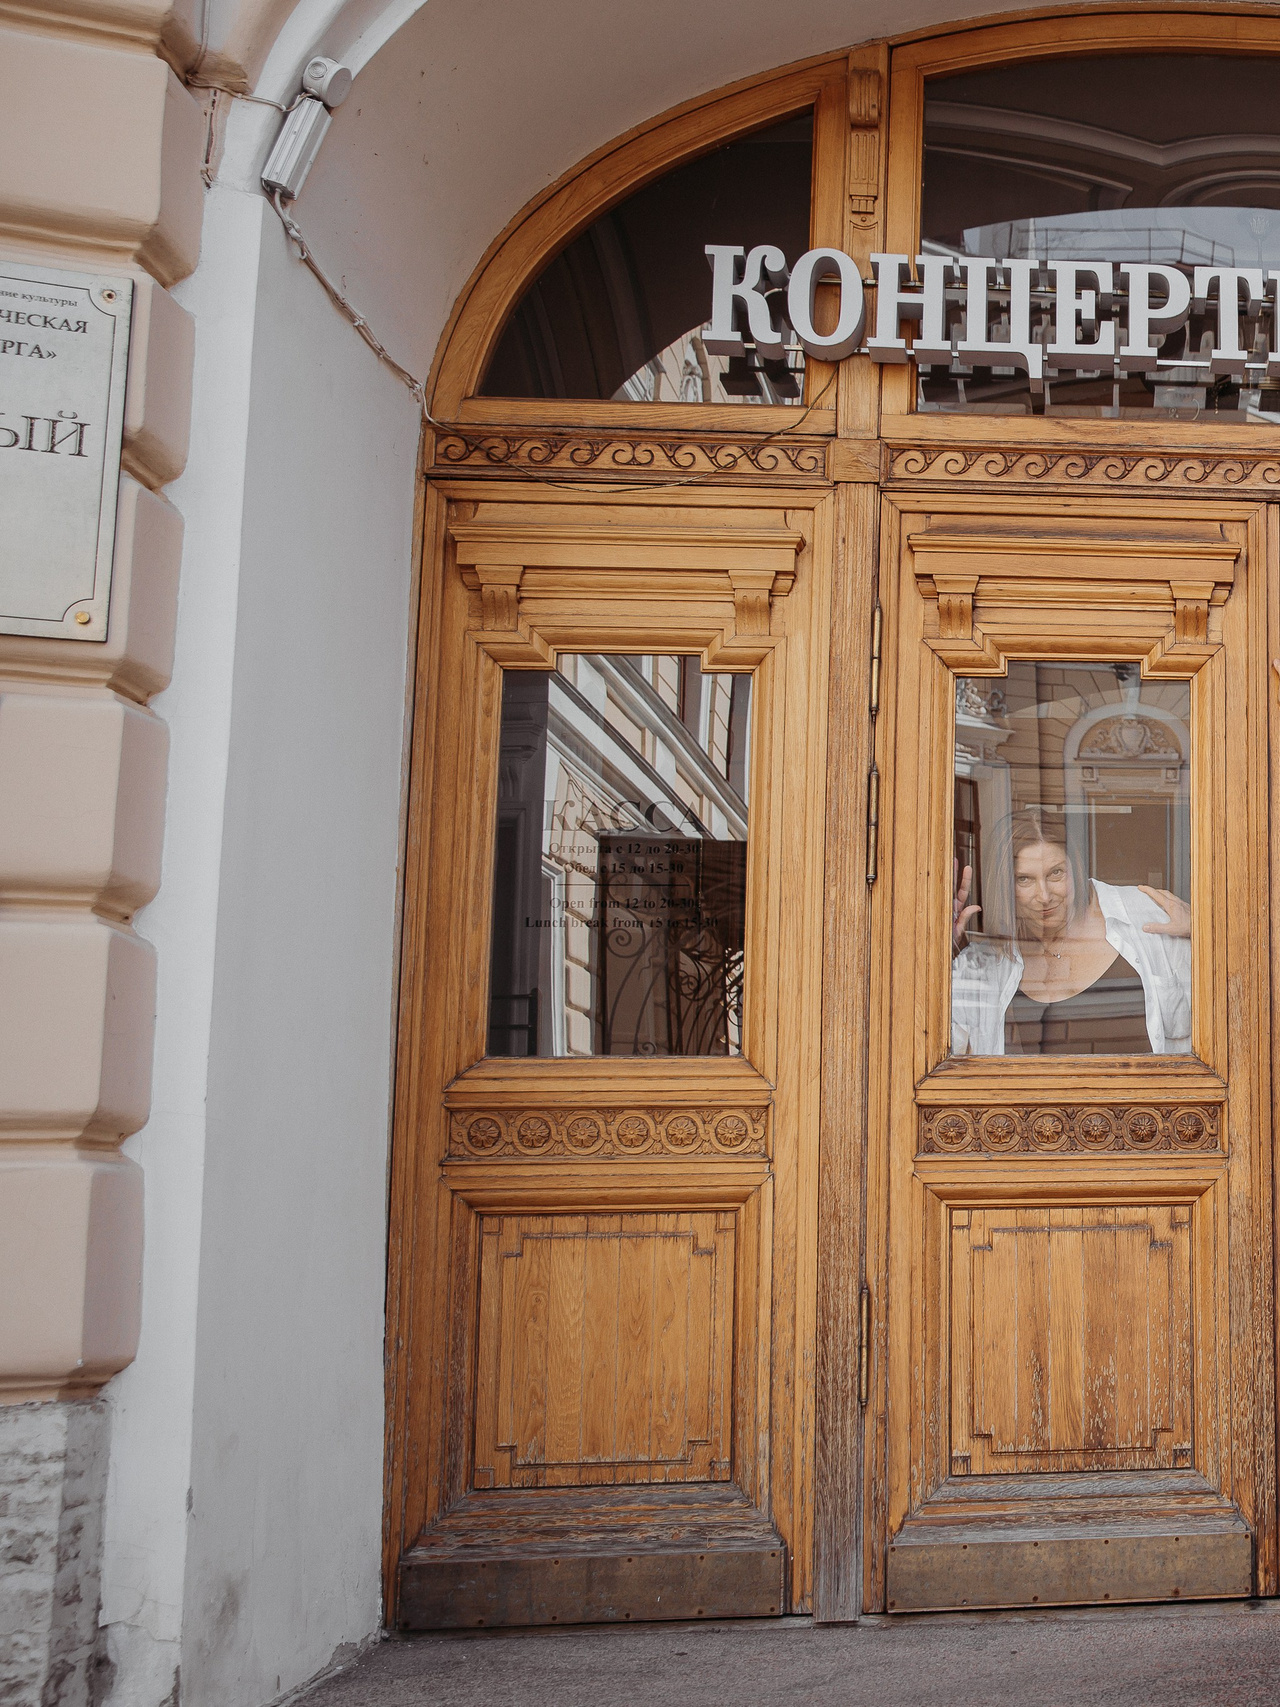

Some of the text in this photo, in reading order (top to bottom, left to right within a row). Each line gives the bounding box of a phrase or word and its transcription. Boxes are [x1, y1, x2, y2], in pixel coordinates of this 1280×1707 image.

[21, 293, 78, 307] культуры
[0, 309, 89, 334] ЧЕСКАЯ
[544, 800, 708, 833] КАССА
[549, 842, 699, 856] Открыта с 12 до 20-30
[564, 862, 598, 875] Обед
[612, 863, 626, 874] 15
[630, 864, 645, 874] до
[649, 862, 684, 874] 15-30
[549, 897, 695, 912] Open from 12 to 20-30
[525, 917, 719, 928] Lunch break from 15 to 15-30
